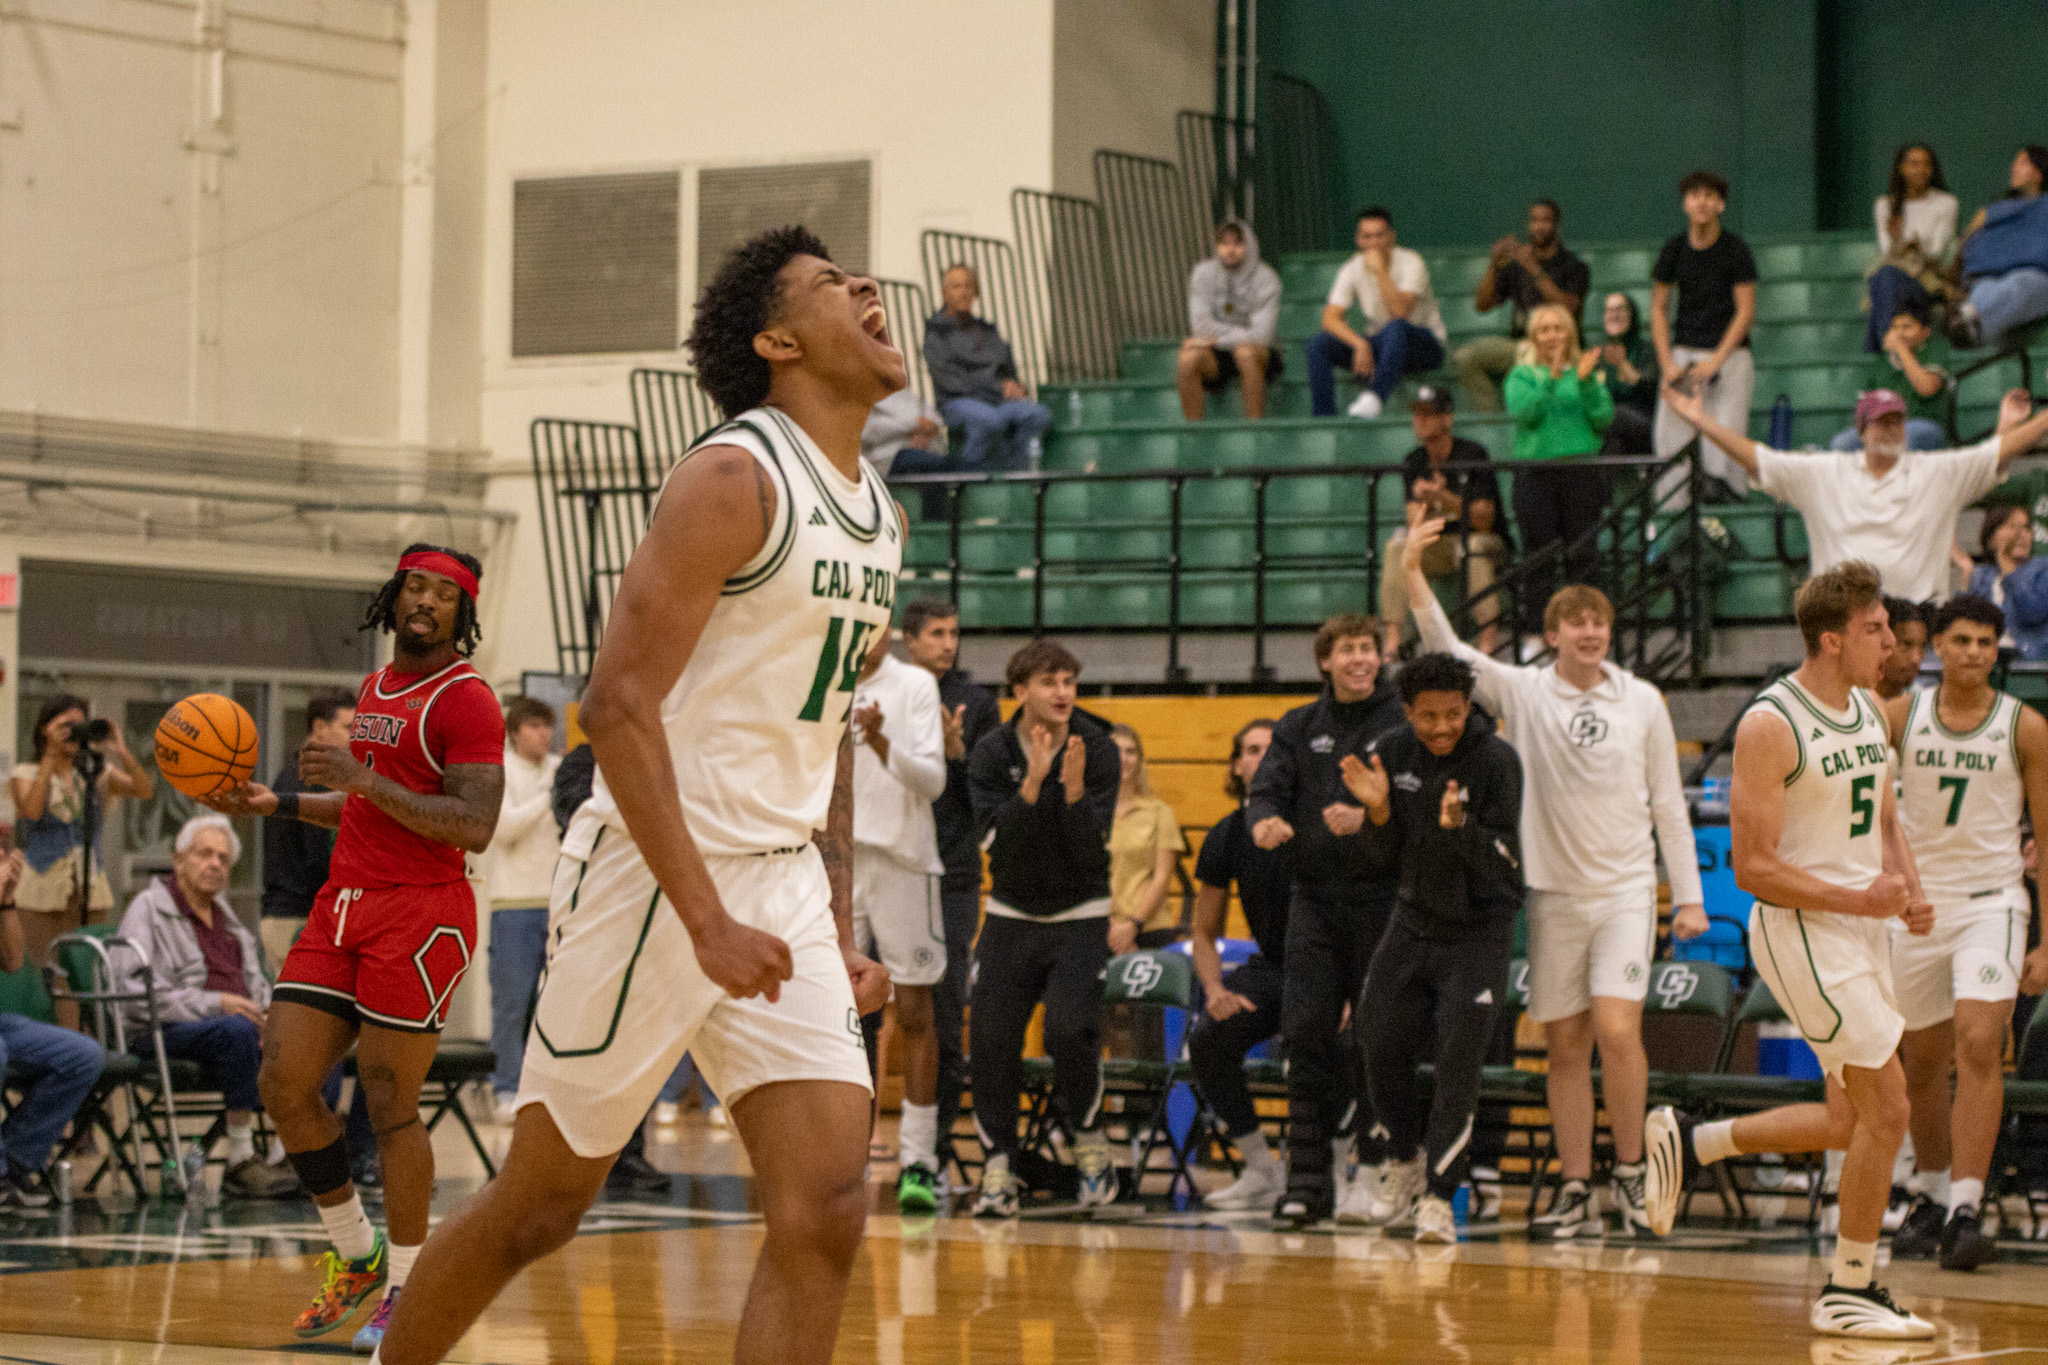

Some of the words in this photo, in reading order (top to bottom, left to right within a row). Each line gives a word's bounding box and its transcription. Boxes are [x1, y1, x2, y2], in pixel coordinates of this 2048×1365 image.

[811, 559, 853, 599] CAL
[860, 565, 895, 609] POL
[1821, 748, 1854, 778] CAL
[1916, 749, 1947, 768] CAL
[1954, 751, 1998, 772] POLY
[1849, 774, 1876, 839] 5
[1938, 775, 1969, 827] 7
